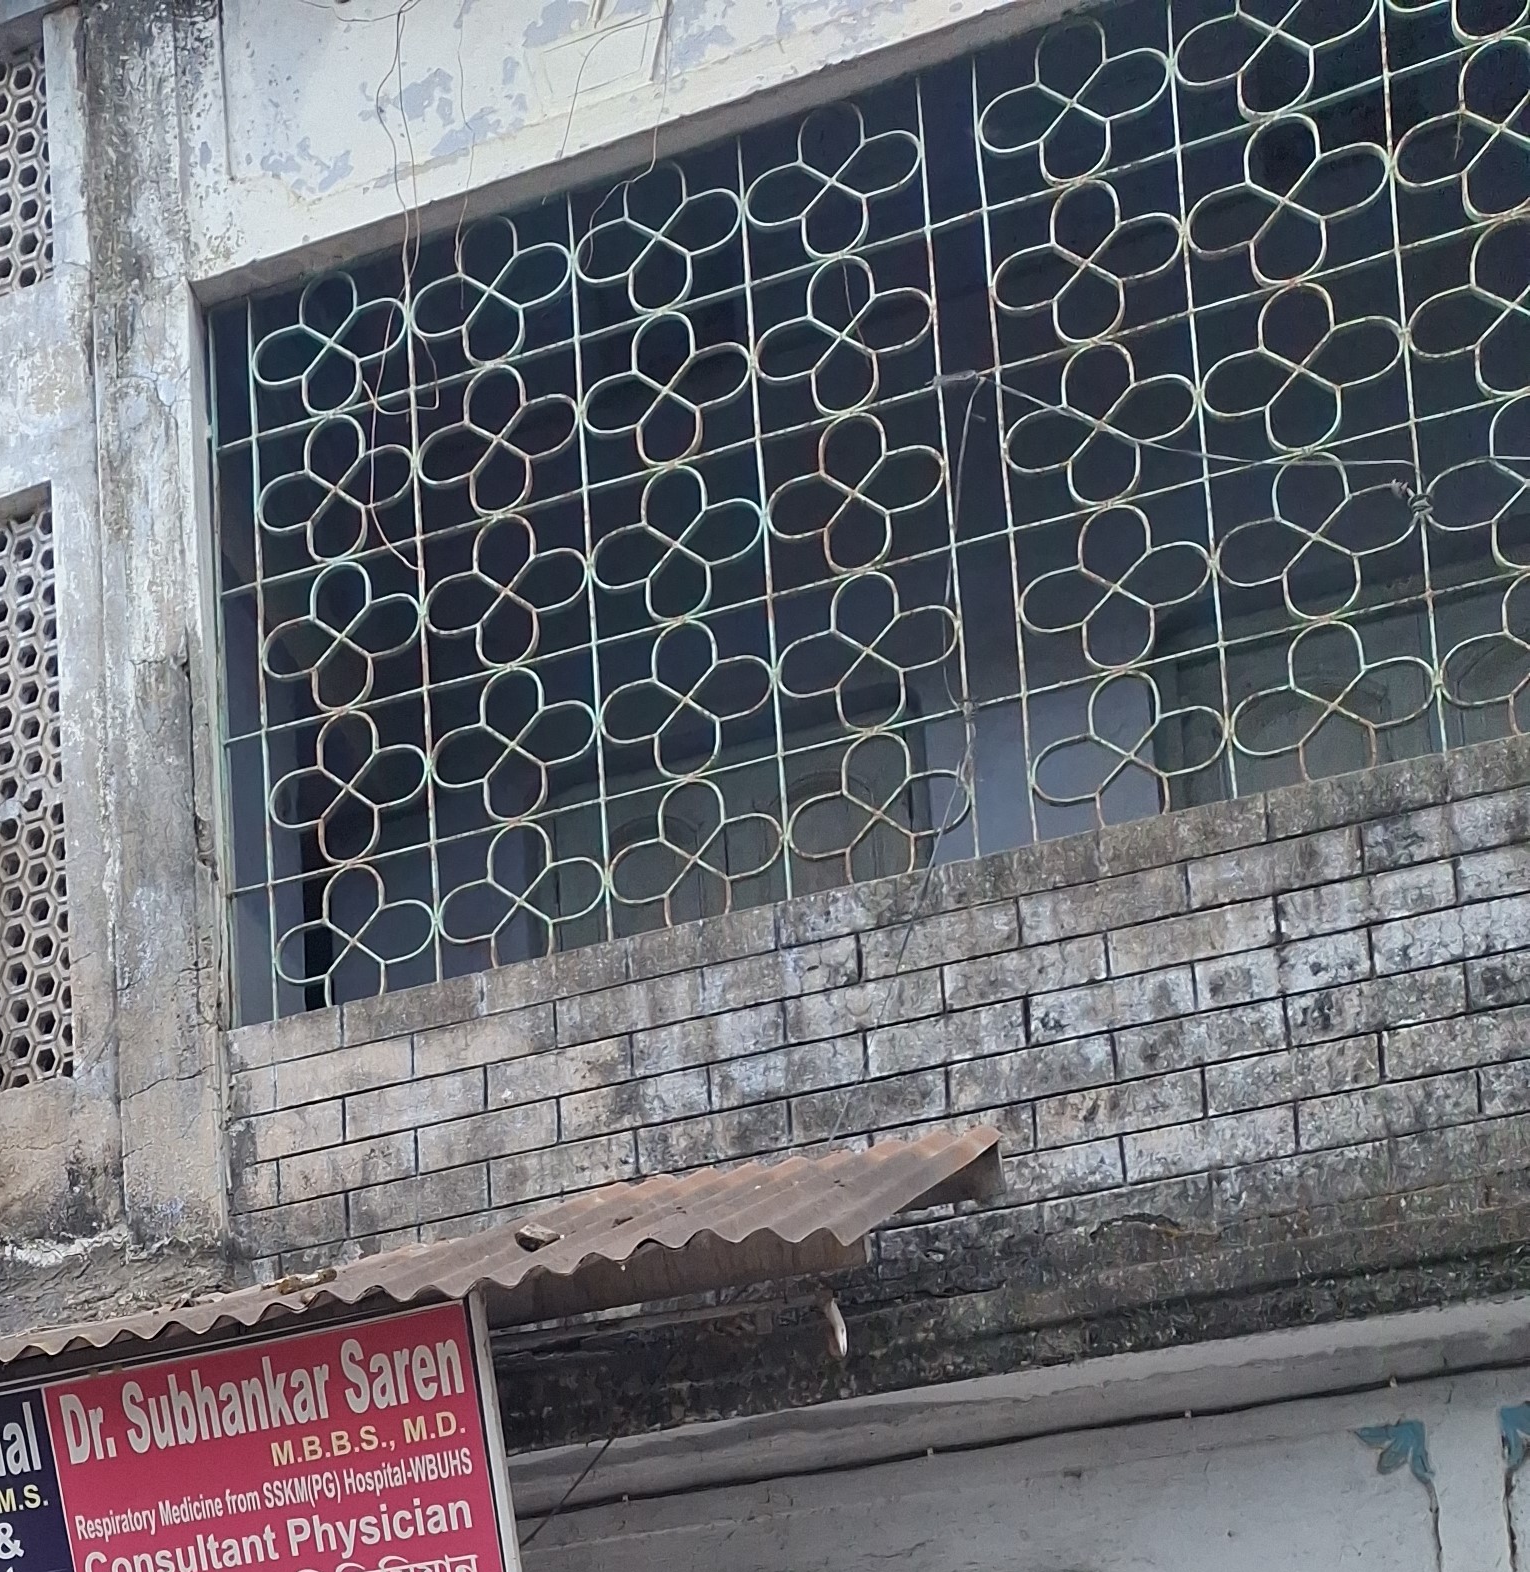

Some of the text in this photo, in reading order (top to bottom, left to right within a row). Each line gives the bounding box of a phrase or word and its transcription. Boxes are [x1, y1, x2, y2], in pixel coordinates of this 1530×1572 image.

[59, 1338, 466, 1466] Dr. Subhankar Saren
[271, 1414, 466, 1467] M.B.B.S., M.D.
[74, 1448, 473, 1544] Respiratory Medicine from SSKM(PG) Hospital-WBUHS
[287, 1498, 473, 1558] Physician
